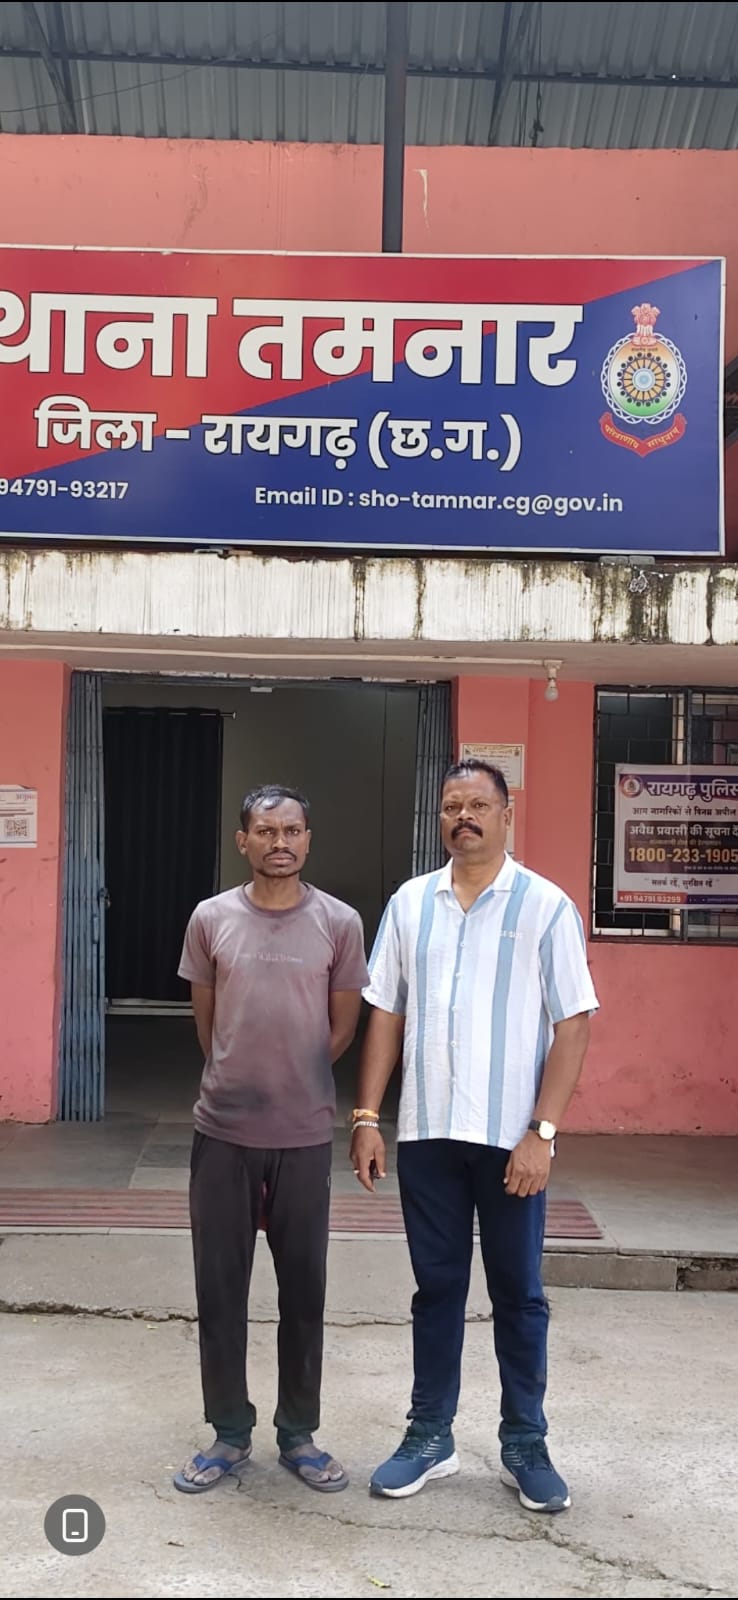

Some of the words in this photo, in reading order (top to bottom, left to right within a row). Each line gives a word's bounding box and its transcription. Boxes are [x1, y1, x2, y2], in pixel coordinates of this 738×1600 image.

[0, 290, 218, 378] थाना
[232, 297, 583, 386] तमनार
[33, 394, 157, 452] जिला
[202, 415, 358, 470] रायगढ़
[368, 411, 522, 472] (छ.ग.)
[0, 478, 129, 500] 94791-93217
[254, 487, 316, 505] Email
[321, 488, 343, 506] ID
[358, 491, 623, 517] sho-tamnar.cg@gov.in
[647, 782, 697, 800] रायगढ़
[629, 822, 655, 836] अवैध
[657, 823, 688, 837] प्रवासी
[689, 823, 703, 837] की
[704, 826, 730, 840] सूचना
[628, 847, 738, 863] 1800-233-1905
